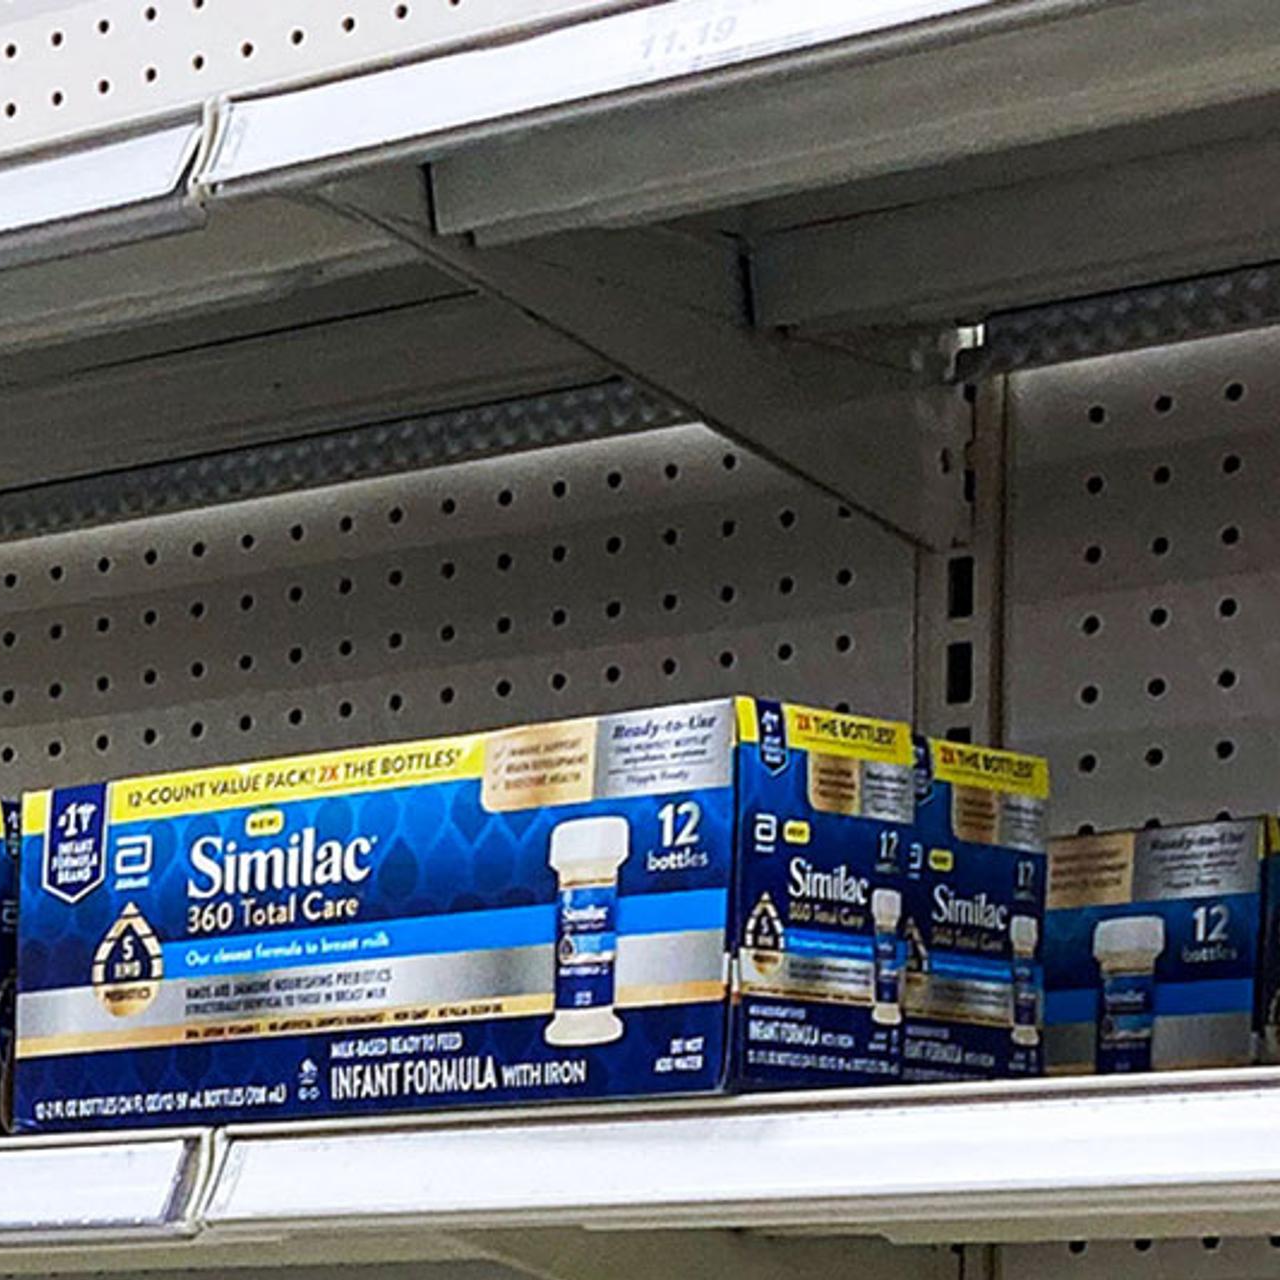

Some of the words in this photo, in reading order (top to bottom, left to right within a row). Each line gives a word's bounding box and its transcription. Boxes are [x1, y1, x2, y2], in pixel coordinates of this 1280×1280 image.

[129, 781, 206, 807] 12-COUNT
[209, 775, 260, 796] VALUE
[318, 766, 339, 784] 2X
[344, 760, 375, 778] THE
[658, 802, 700, 848] 12
[188, 828, 372, 899] Similac
[647, 848, 708, 871] bottles
[789, 856, 868, 906] Similac
[187, 904, 234, 933] 360
[241, 899, 296, 927] Total
[302, 893, 359, 921] Care
[932, 884, 1007, 930] Similac
[1192, 904, 1229, 943] 12
[331, 1063, 400, 1100] INFANT
[403, 1056, 497, 1095] FORMULA
[501, 1065, 541, 1087] WITH
[544, 1060, 586, 1084] IRON
